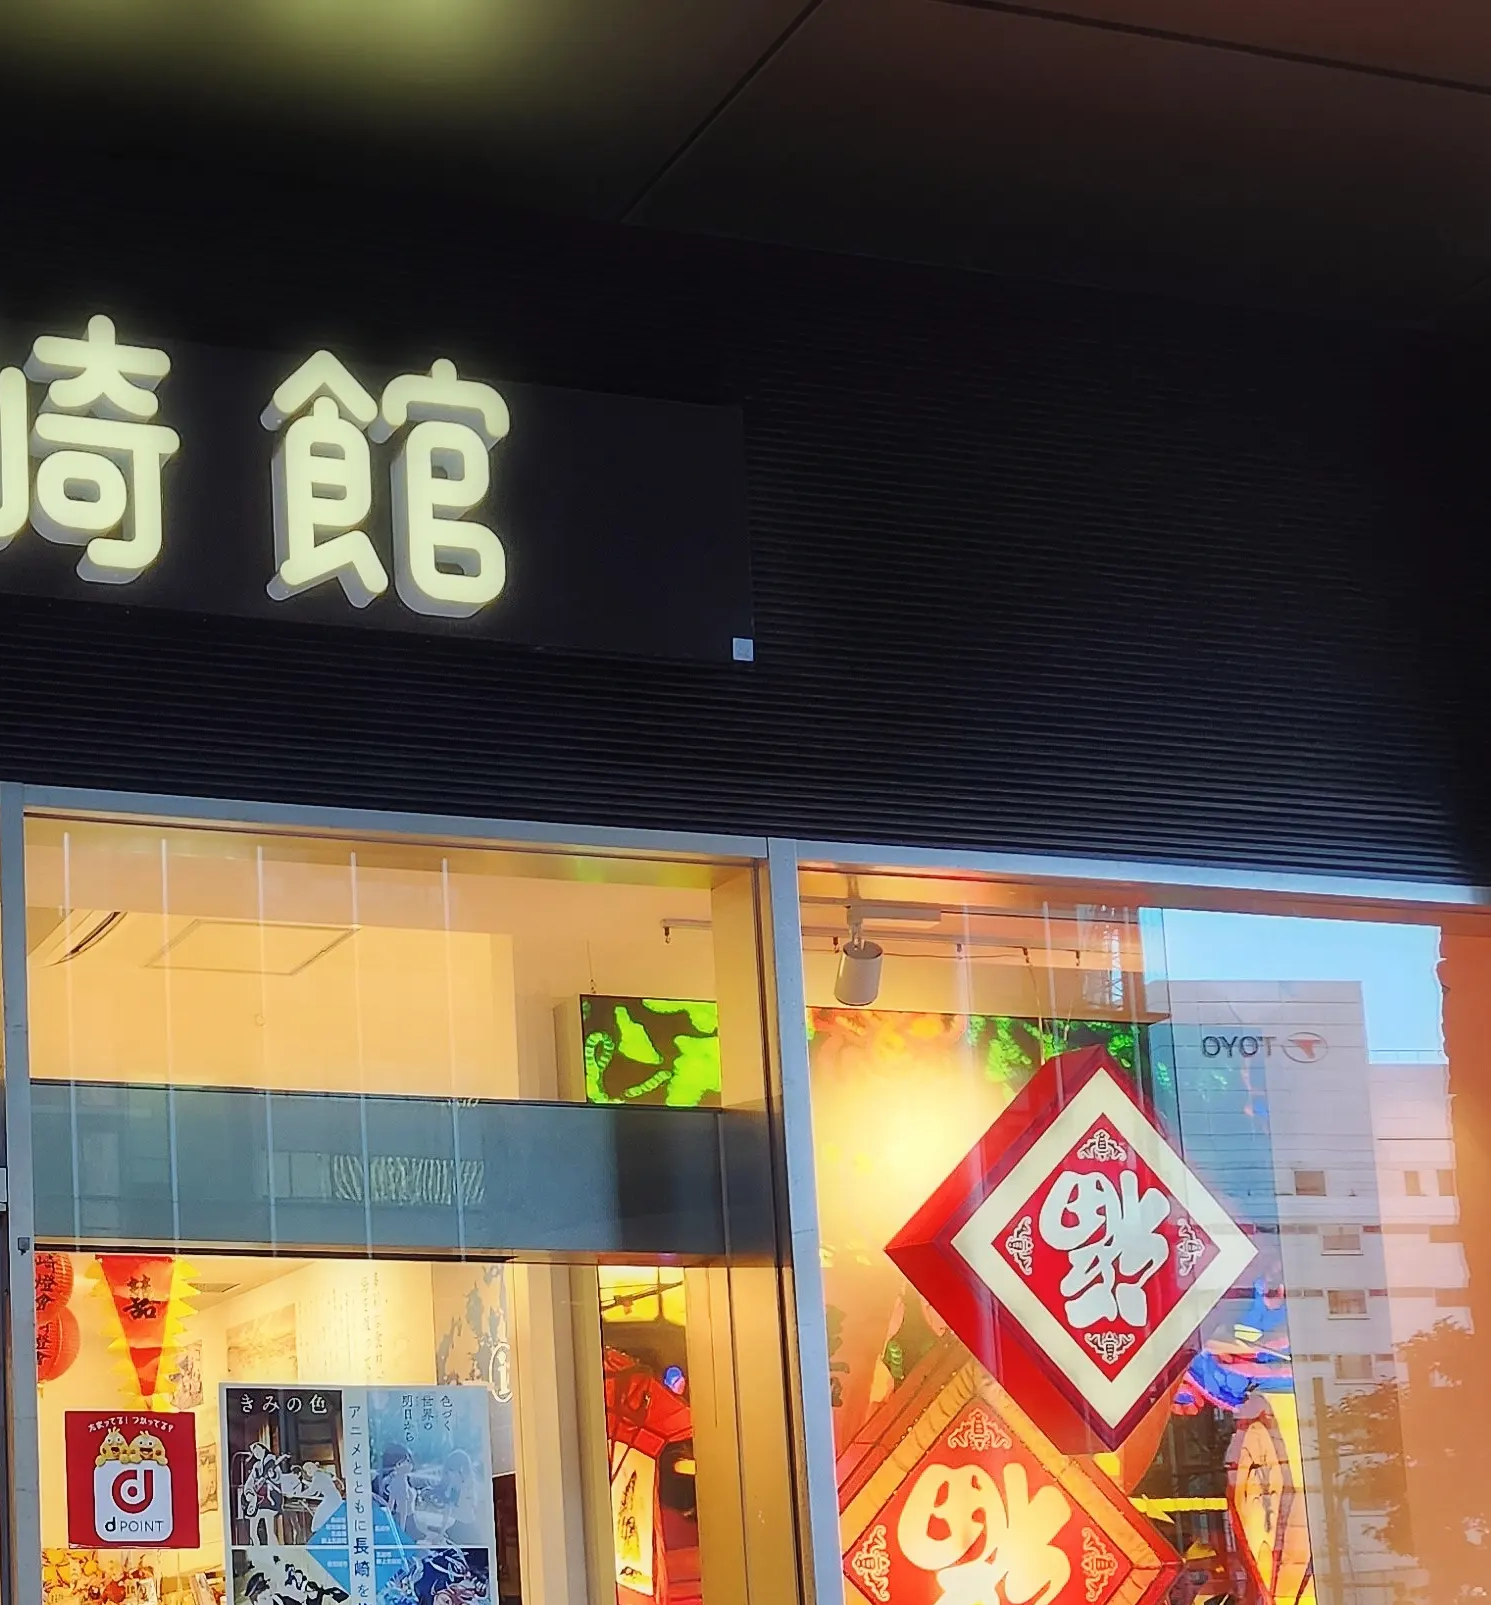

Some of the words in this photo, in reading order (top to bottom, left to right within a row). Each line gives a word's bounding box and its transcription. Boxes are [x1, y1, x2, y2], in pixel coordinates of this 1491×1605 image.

[240, 1394, 328, 1414] きみの色
[422, 1394, 435, 1431] 世界の
[120, 1520, 164, 1533] POINT
